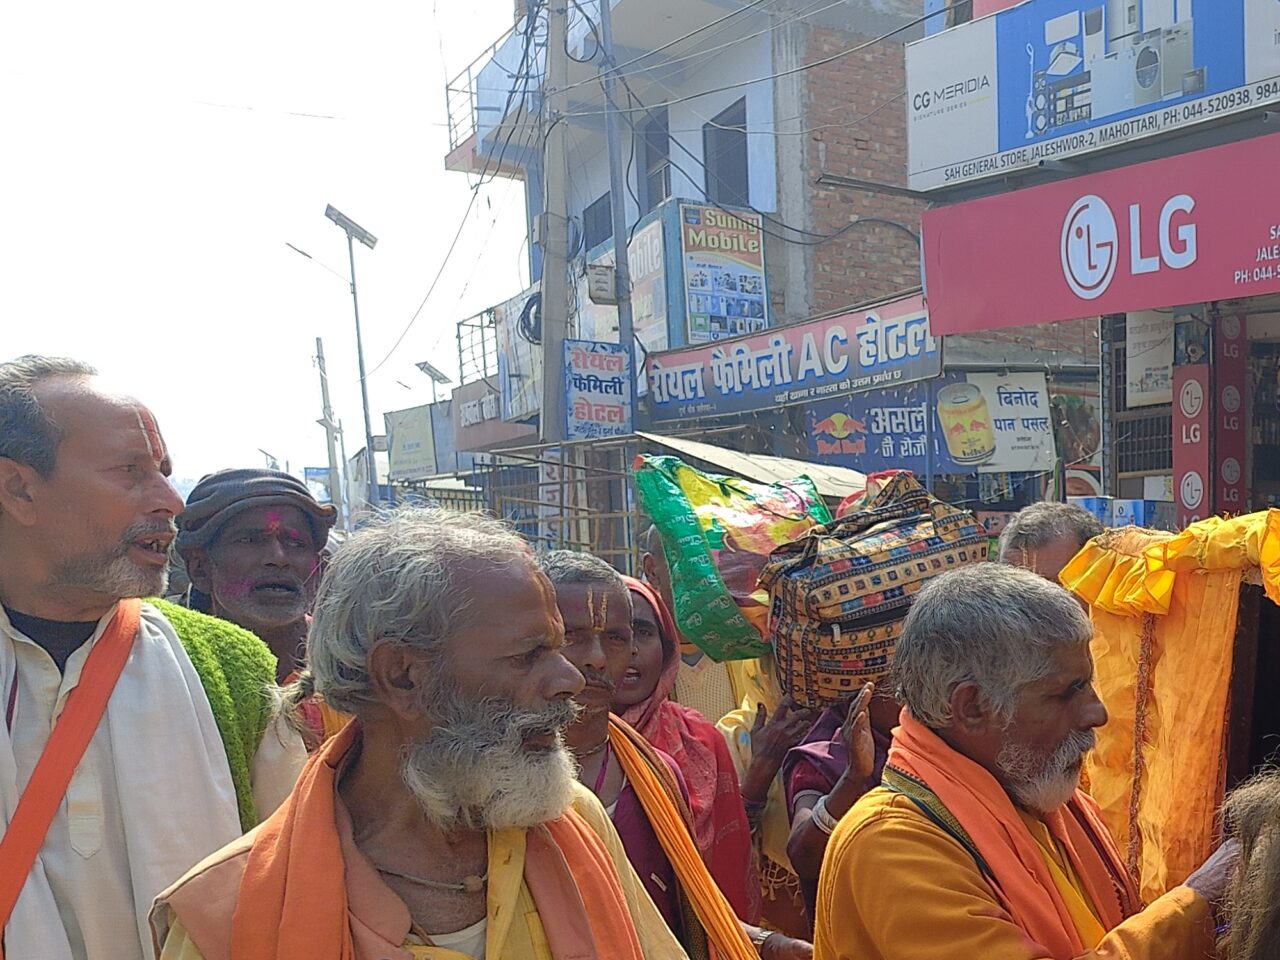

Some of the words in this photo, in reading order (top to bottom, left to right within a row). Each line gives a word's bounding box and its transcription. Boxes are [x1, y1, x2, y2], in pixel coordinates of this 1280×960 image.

[913, 91, 930, 111] CG
[933, 75, 990, 104] MERIDIA
[944, 164, 961, 181] SAH
[962, 156, 999, 177] GENERAL
[1000, 150, 1030, 168] STORE,
[1100, 118, 1160, 142] MAHOTTARI,
[1163, 111, 1181, 127] PH:
[1183, 91, 1253, 120] 044-520938,
[705, 209, 758, 235] Sunny
[1129, 194, 1198, 275] LG
[1234, 270, 1251, 284] PH:
[797, 325, 849, 381] AC
[856, 310, 936, 367] होटल
[1223, 343, 1239, 358] LG
[993, 418, 1017, 432] पान
[1181, 423, 1201, 444] LG
[1223, 415, 1239, 431] LG
[1223, 487, 1239, 502] LG
